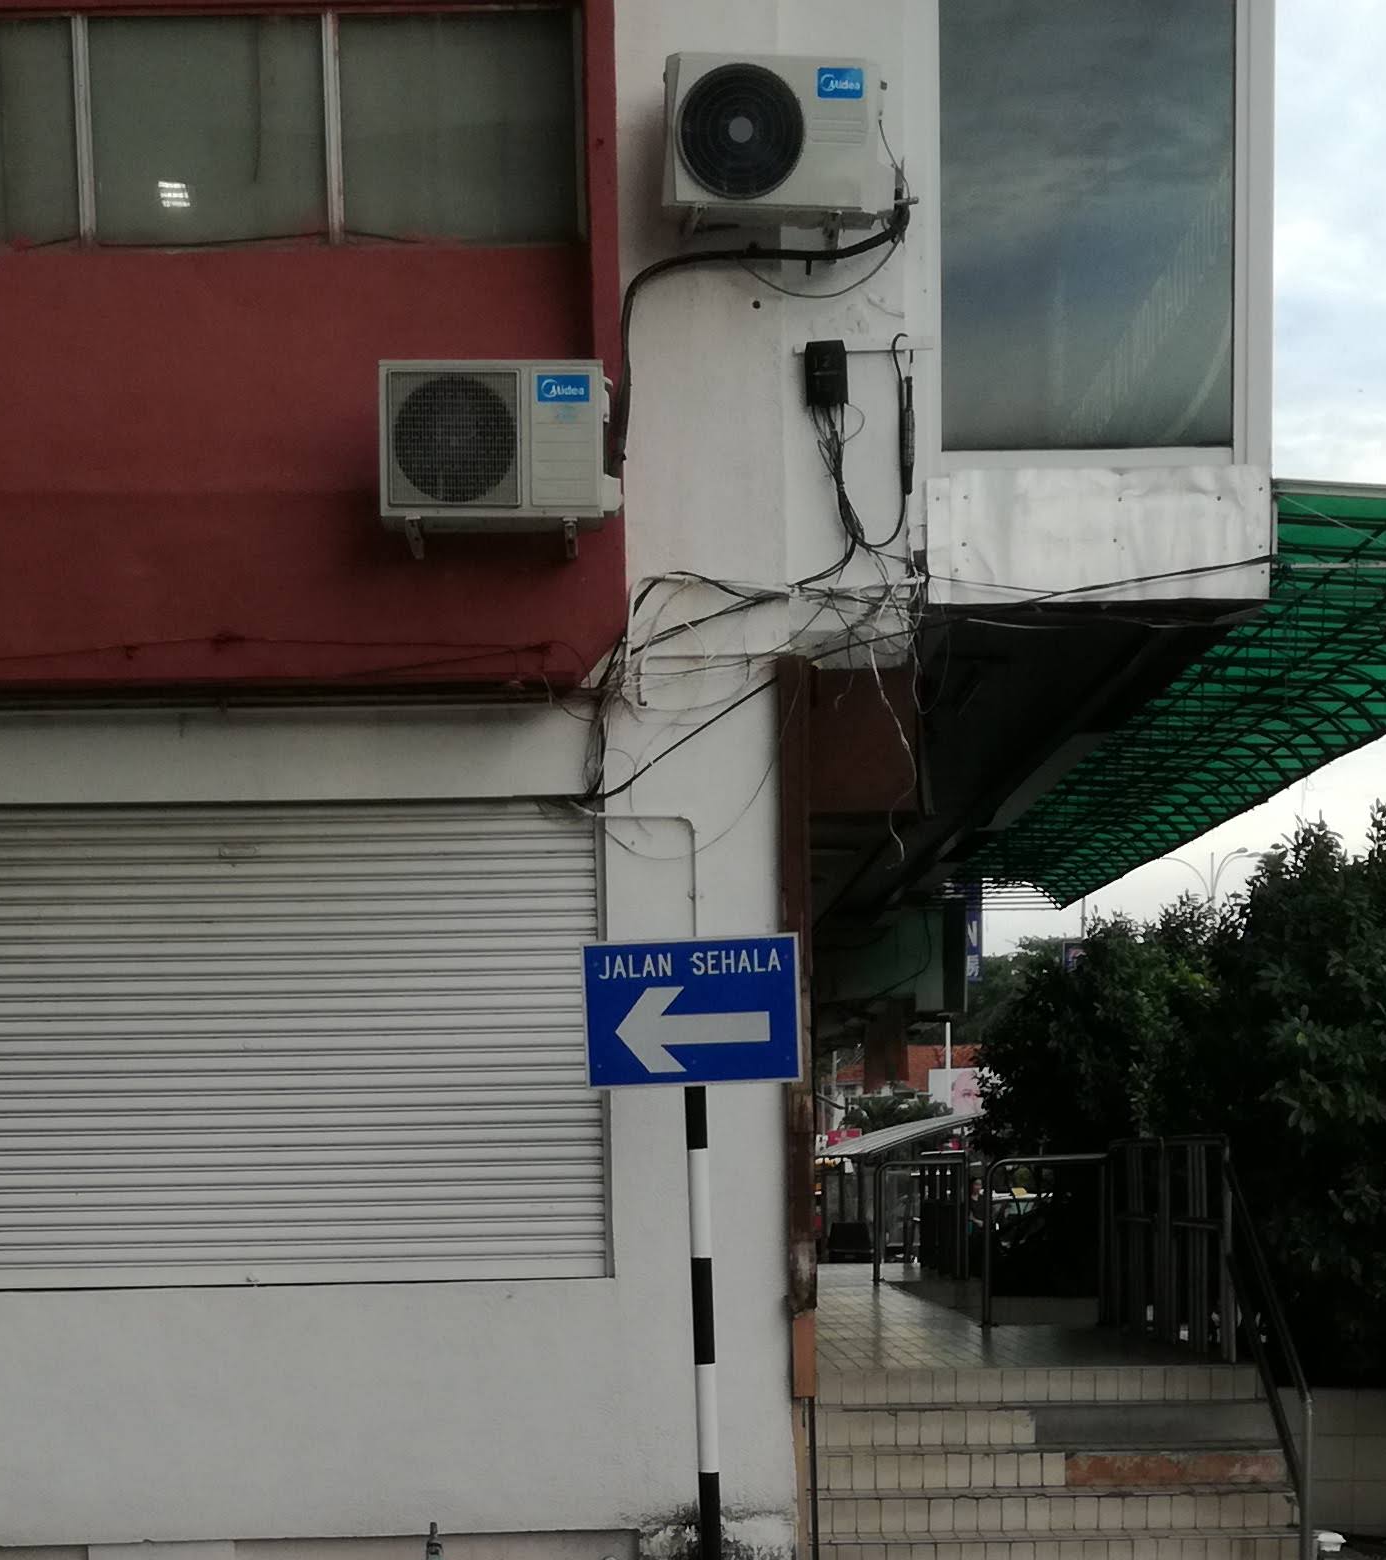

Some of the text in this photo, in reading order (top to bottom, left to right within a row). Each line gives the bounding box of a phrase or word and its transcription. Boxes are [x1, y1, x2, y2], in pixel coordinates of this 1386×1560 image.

[823, 76, 861, 91] Midea
[545, 382, 585, 397] Midea
[598, 947, 782, 981] JALAN SEHALA
